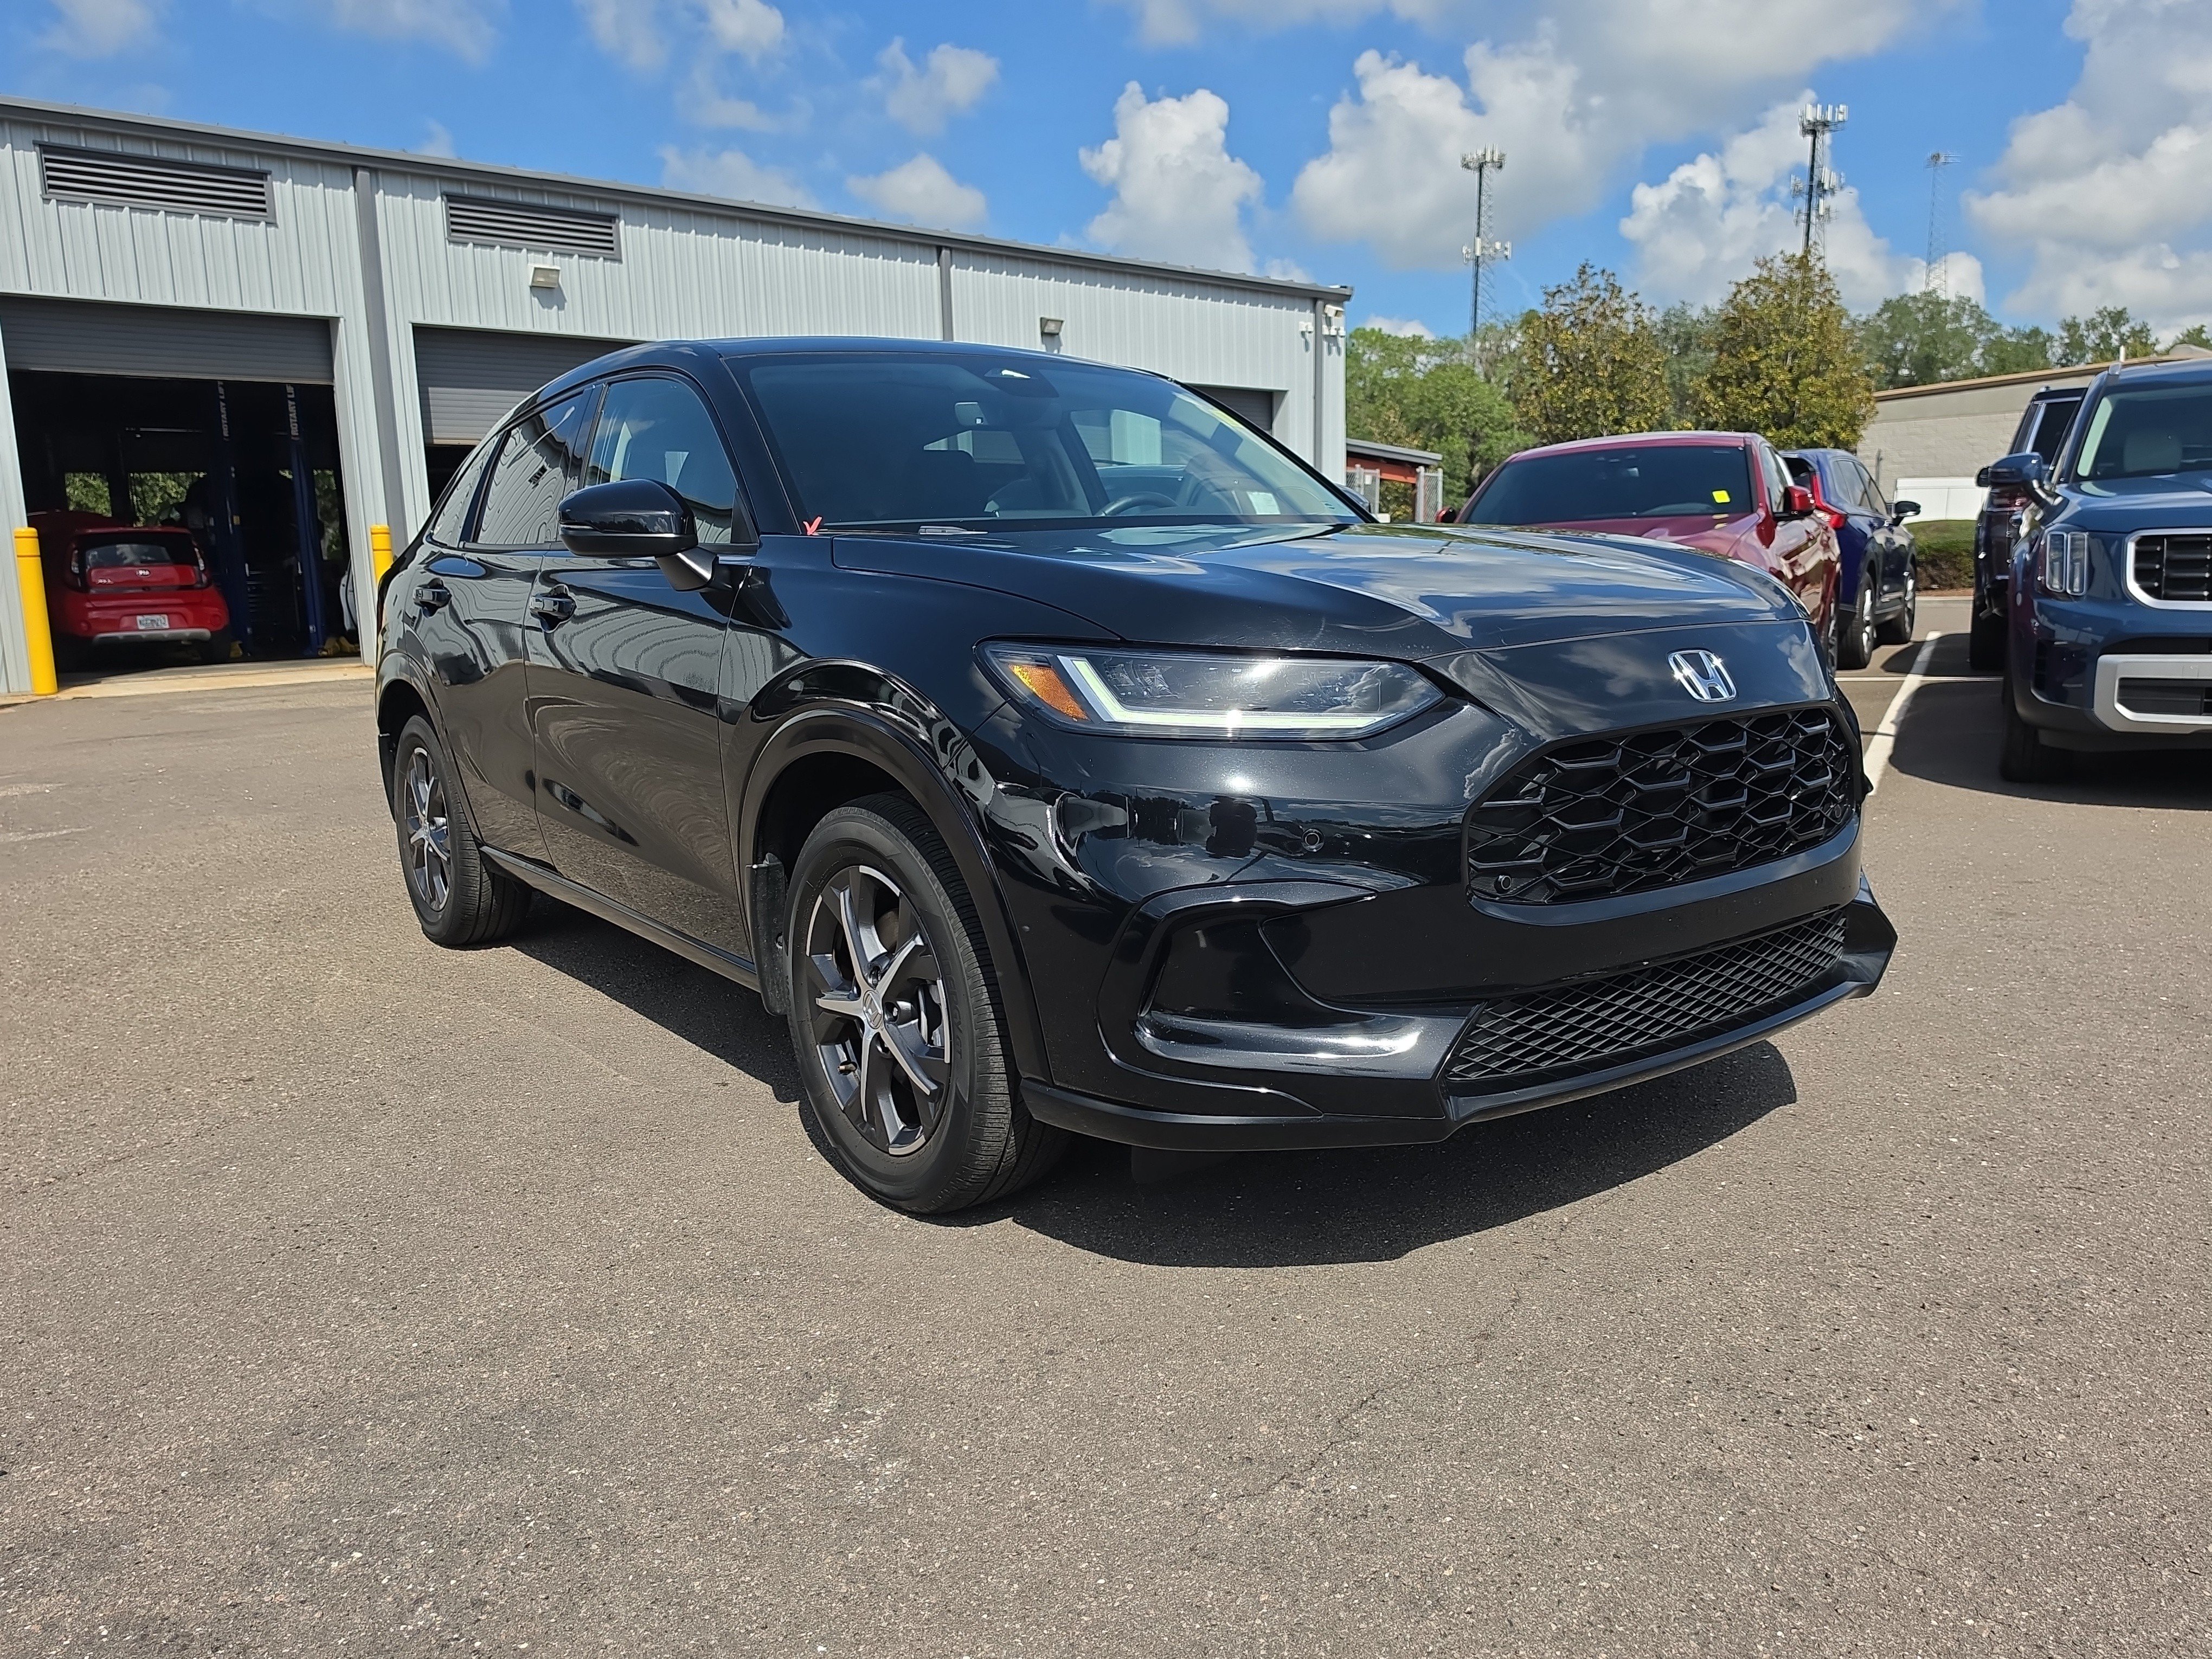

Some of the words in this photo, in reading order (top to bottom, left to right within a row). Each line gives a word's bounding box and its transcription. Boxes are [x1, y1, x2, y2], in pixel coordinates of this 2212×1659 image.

[286, 384, 295, 398] LIF
[220, 400, 229, 436] ROTARY
[288, 400, 299, 435] ROTARY
